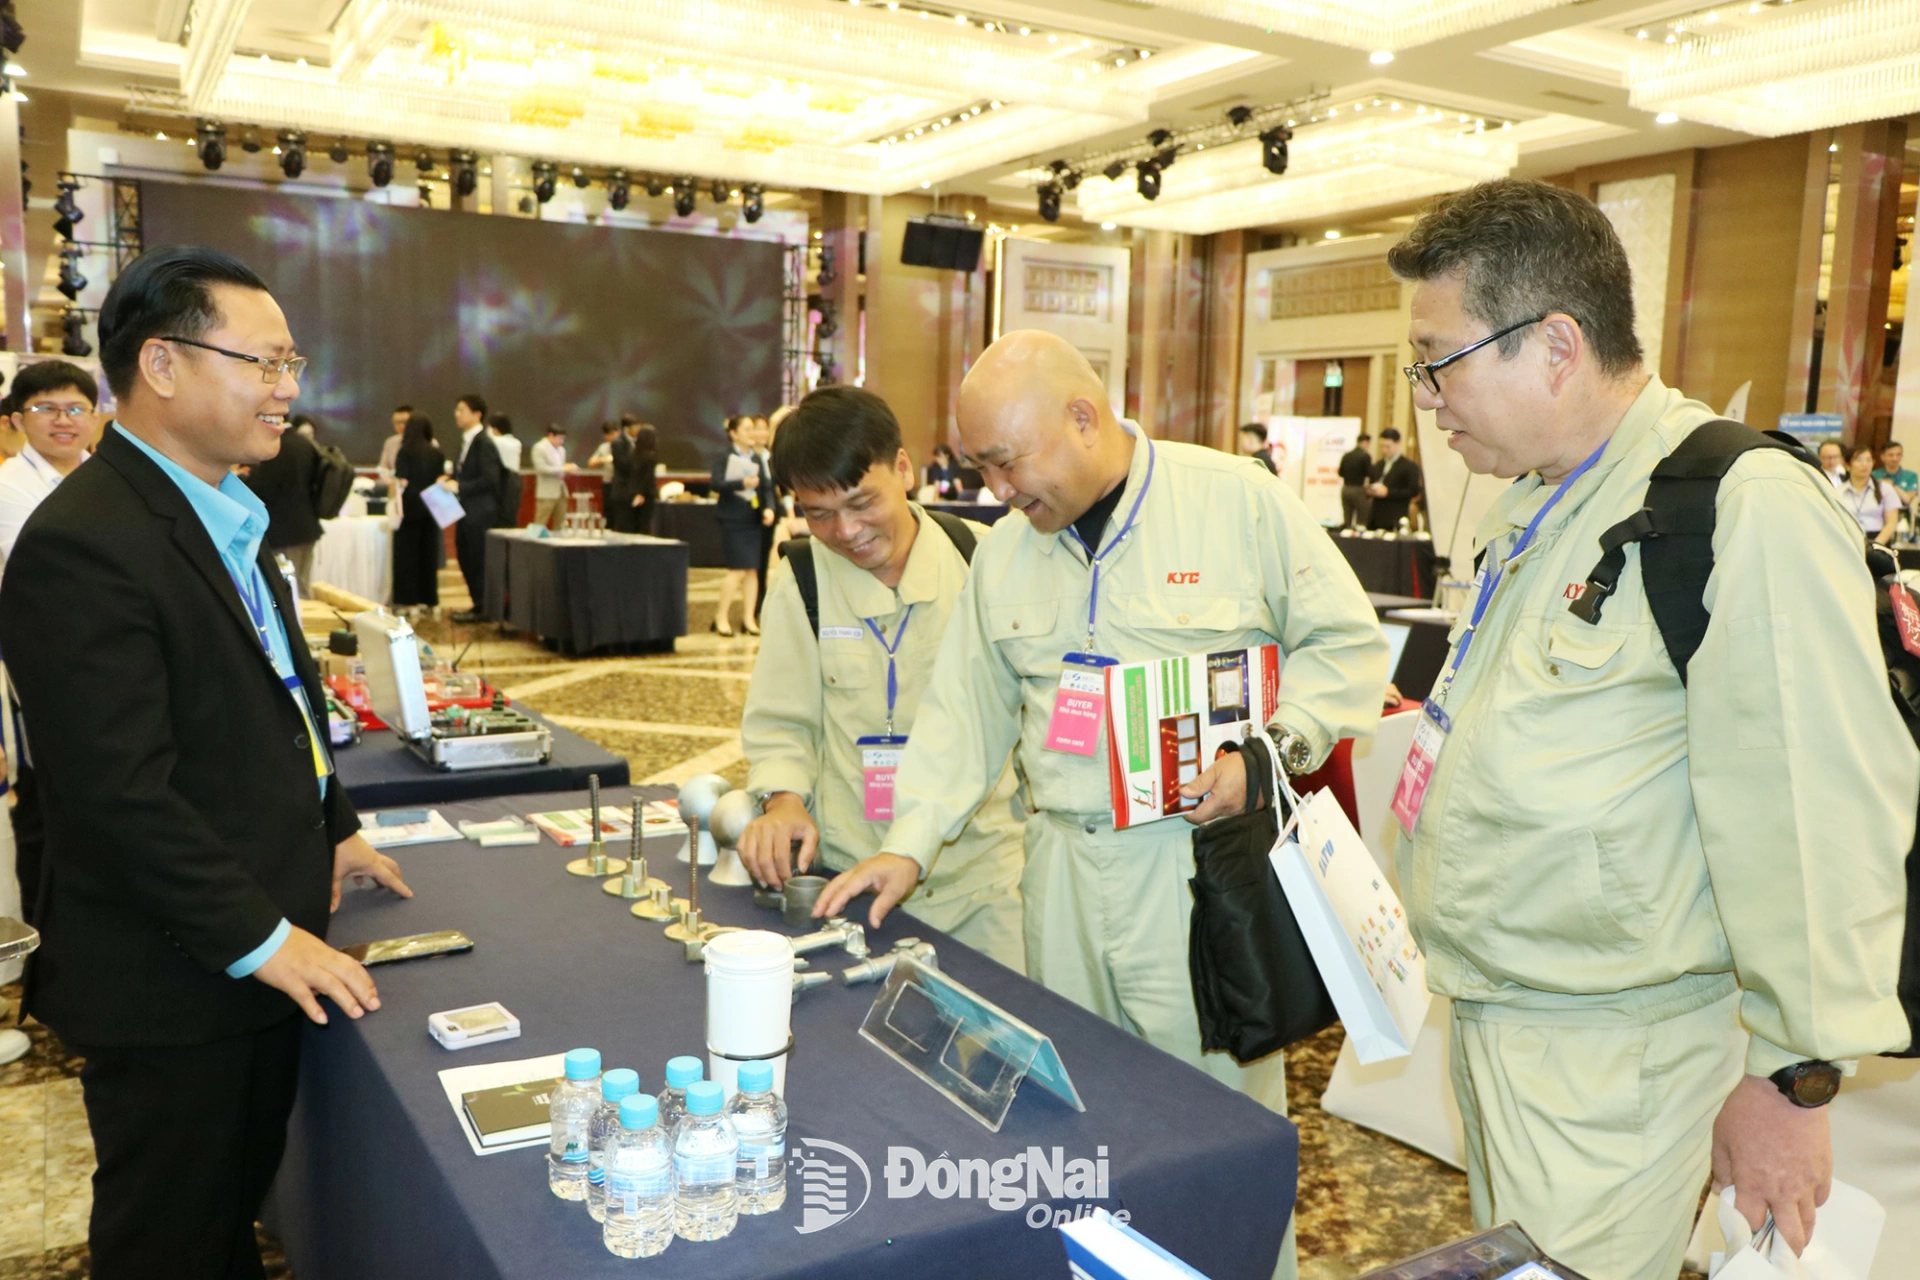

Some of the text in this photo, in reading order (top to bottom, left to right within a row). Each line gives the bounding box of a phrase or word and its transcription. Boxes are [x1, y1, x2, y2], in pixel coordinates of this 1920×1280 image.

[1167, 571, 1200, 584] KYC
[1562, 583, 1588, 599] KY
[1066, 698, 1093, 709] BUYER
